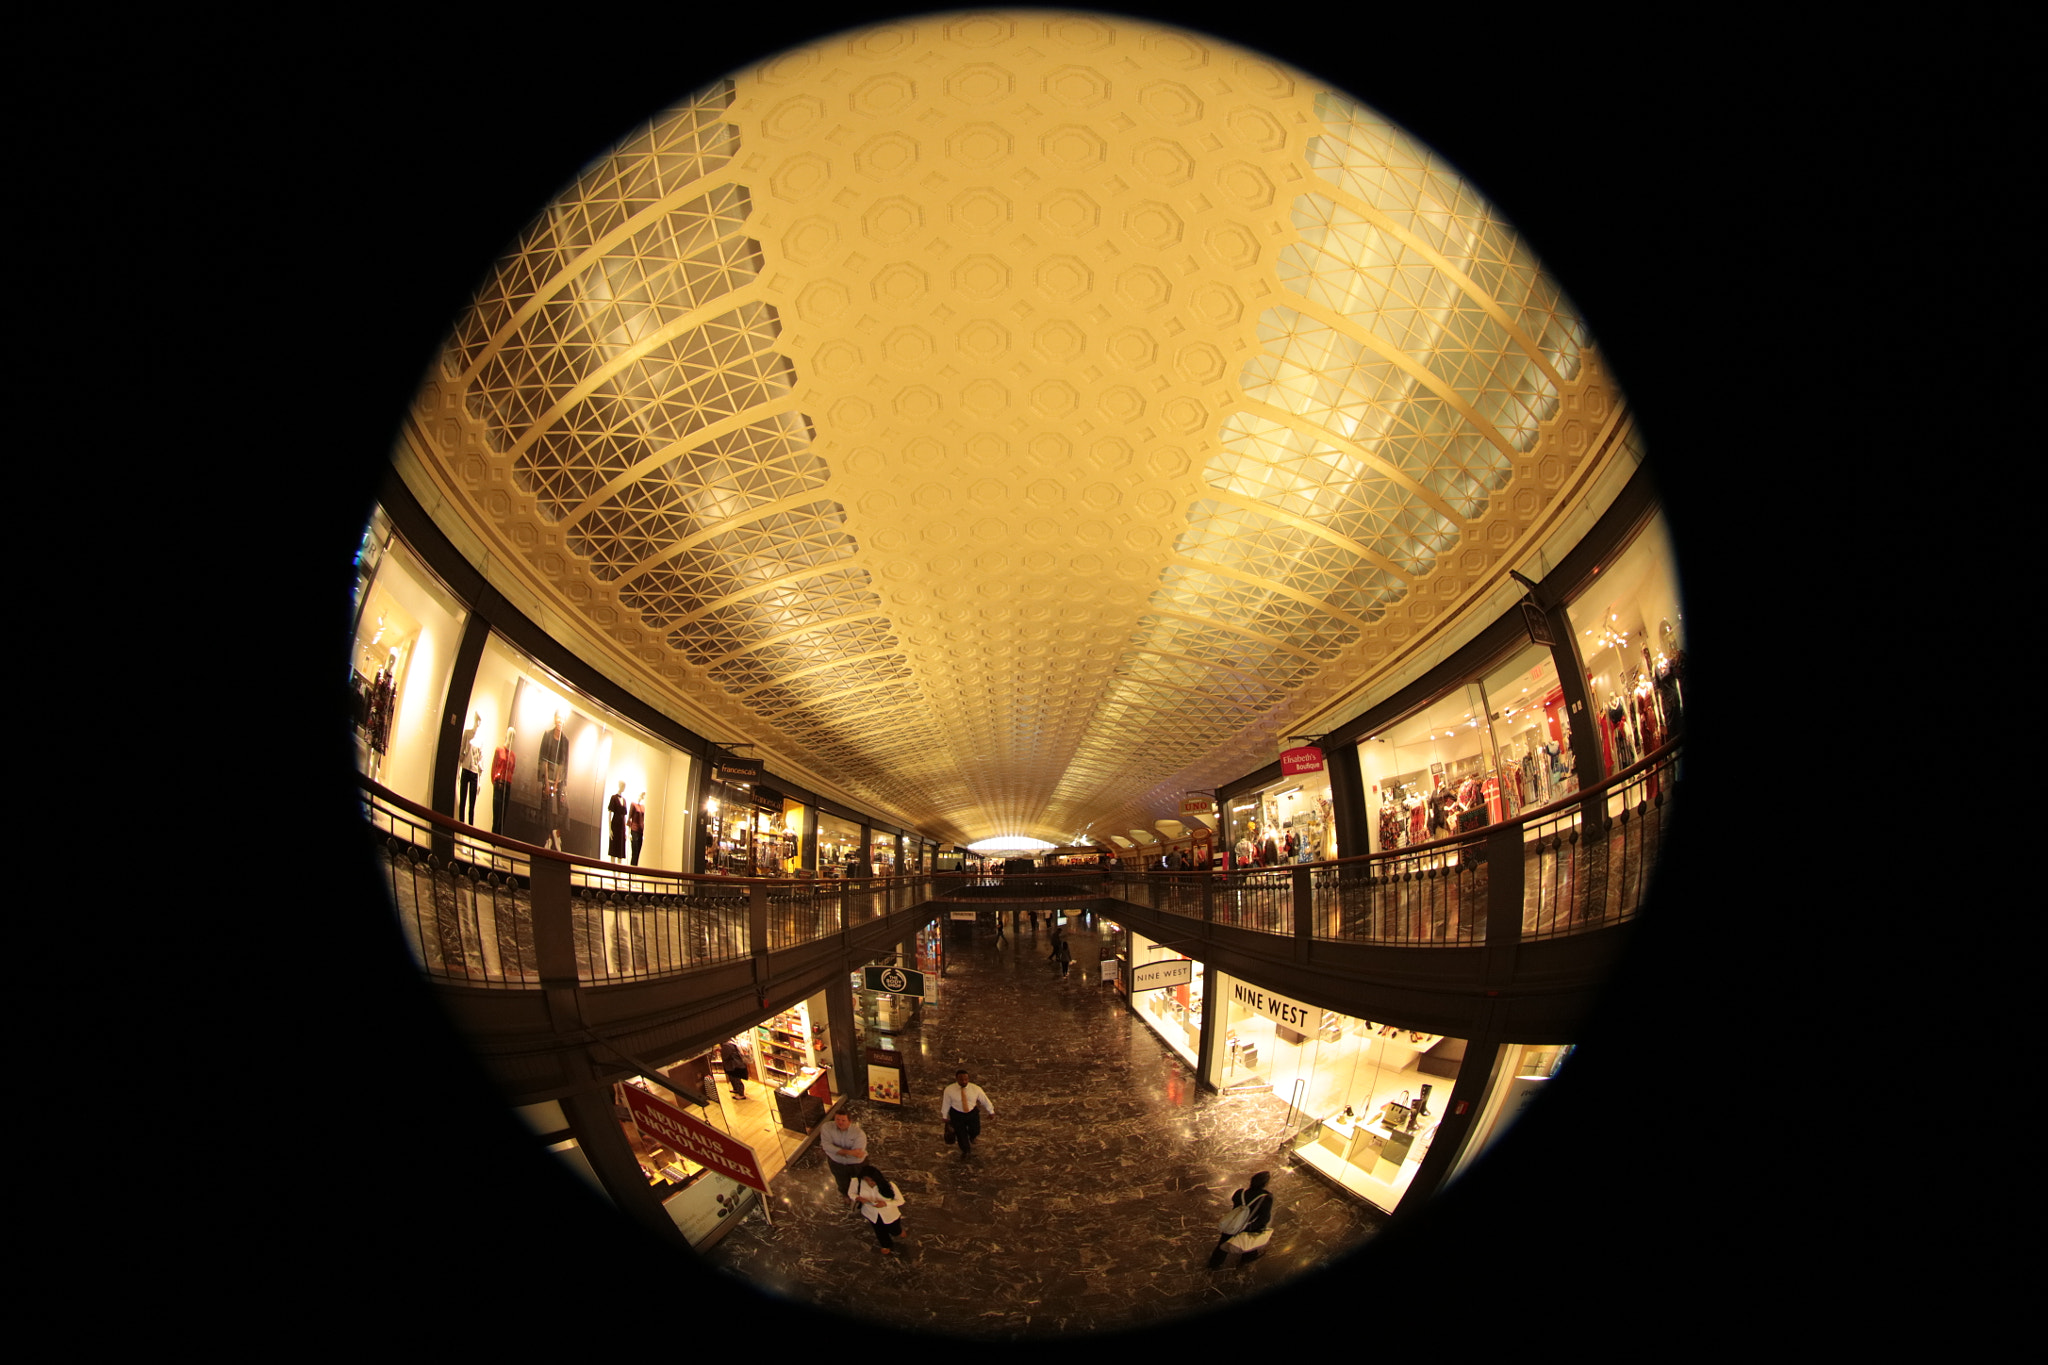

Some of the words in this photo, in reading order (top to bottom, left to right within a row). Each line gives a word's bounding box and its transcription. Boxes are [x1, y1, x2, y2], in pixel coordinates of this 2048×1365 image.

[1282, 753, 1317, 765] Elisabeth's
[721, 763, 757, 777] francesca's
[1296, 762, 1320, 771] Boutique
[1184, 801, 1208, 811] UNO
[1137, 971, 1160, 982] NINE
[1164, 967, 1188, 977] WEST
[1235, 983, 1263, 1010] NINE
[1268, 997, 1308, 1028] WEST
[645, 1104, 724, 1154] NEUHAUS
[634, 1110, 756, 1179] CHOCOLATIER
